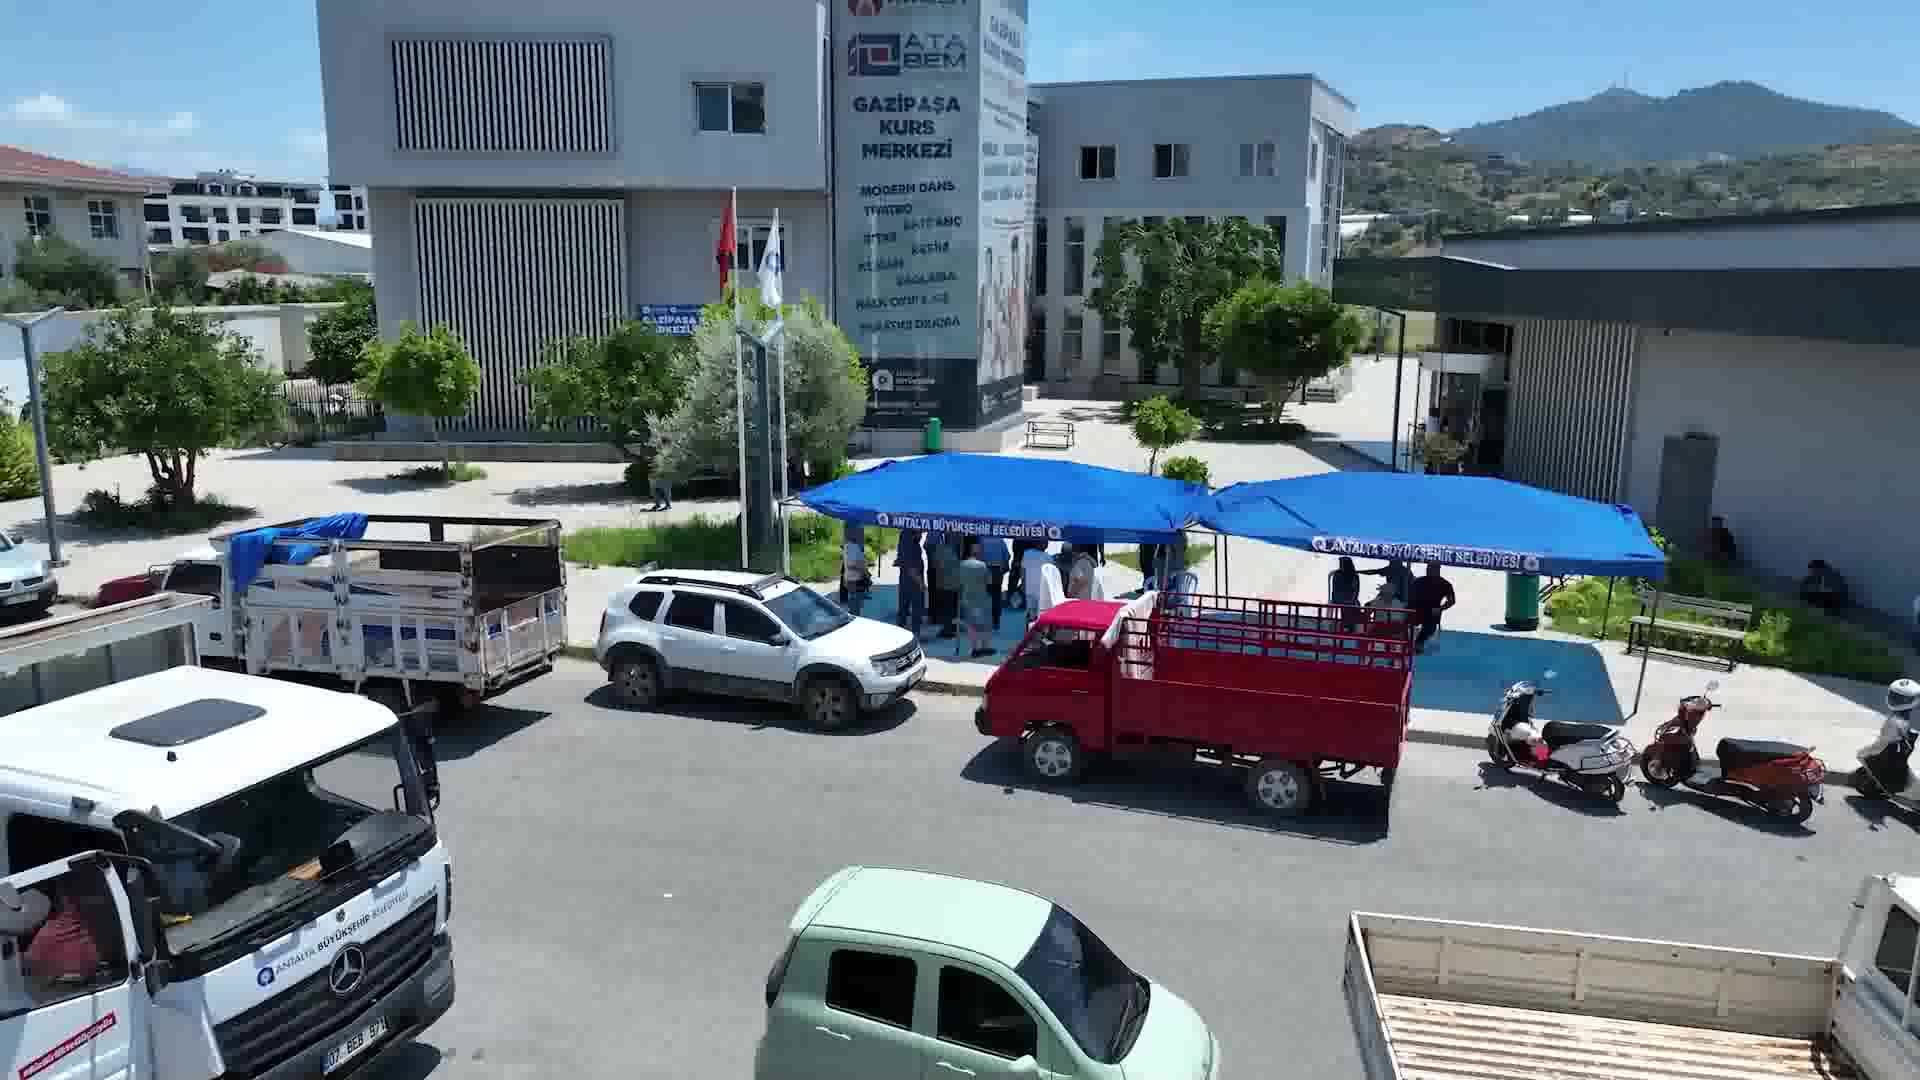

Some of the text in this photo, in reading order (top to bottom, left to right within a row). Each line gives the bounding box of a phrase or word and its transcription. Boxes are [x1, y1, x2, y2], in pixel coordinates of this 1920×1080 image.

[903, 53, 968, 70] BEM
[853, 93, 960, 115] GAZİPAŞA
[880, 119, 935, 136] KURS
[861, 138, 953, 159] MERKEZİ
[858, 180, 957, 197] MODERN DANS
[892, 517, 931, 530] ANTALYA
[993, 523, 1046, 537] BELEDİYESİ
[1331, 540, 1379, 556] ANTALYA
[317, 914, 369, 952] BÜYÜKŞEHİR
